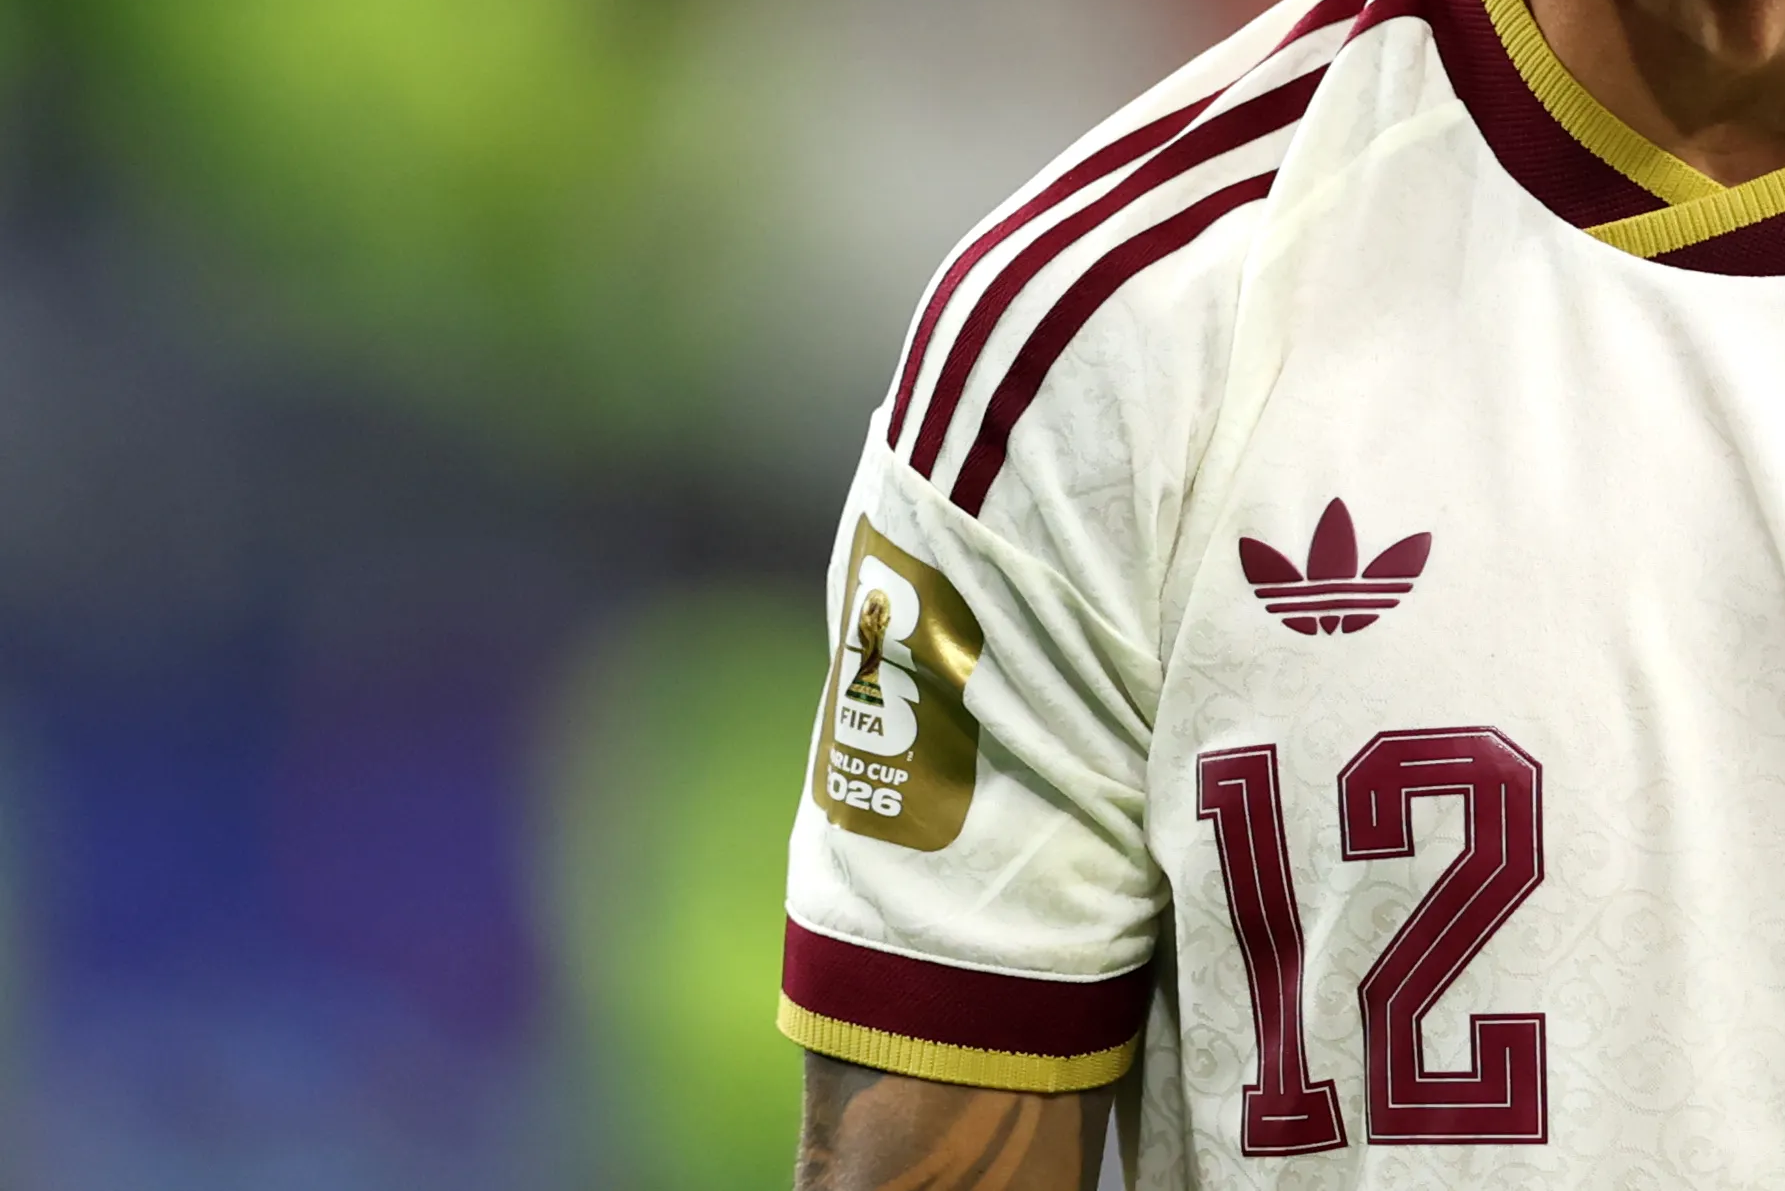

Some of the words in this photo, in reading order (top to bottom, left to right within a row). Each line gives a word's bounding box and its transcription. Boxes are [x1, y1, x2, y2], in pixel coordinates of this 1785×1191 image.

[840, 706, 885, 737] FIFA
[830, 747, 865, 775] RLD
[867, 763, 909, 786] CUP
[827, 765, 903, 817] 026
[1196, 726, 1548, 1157] 12
